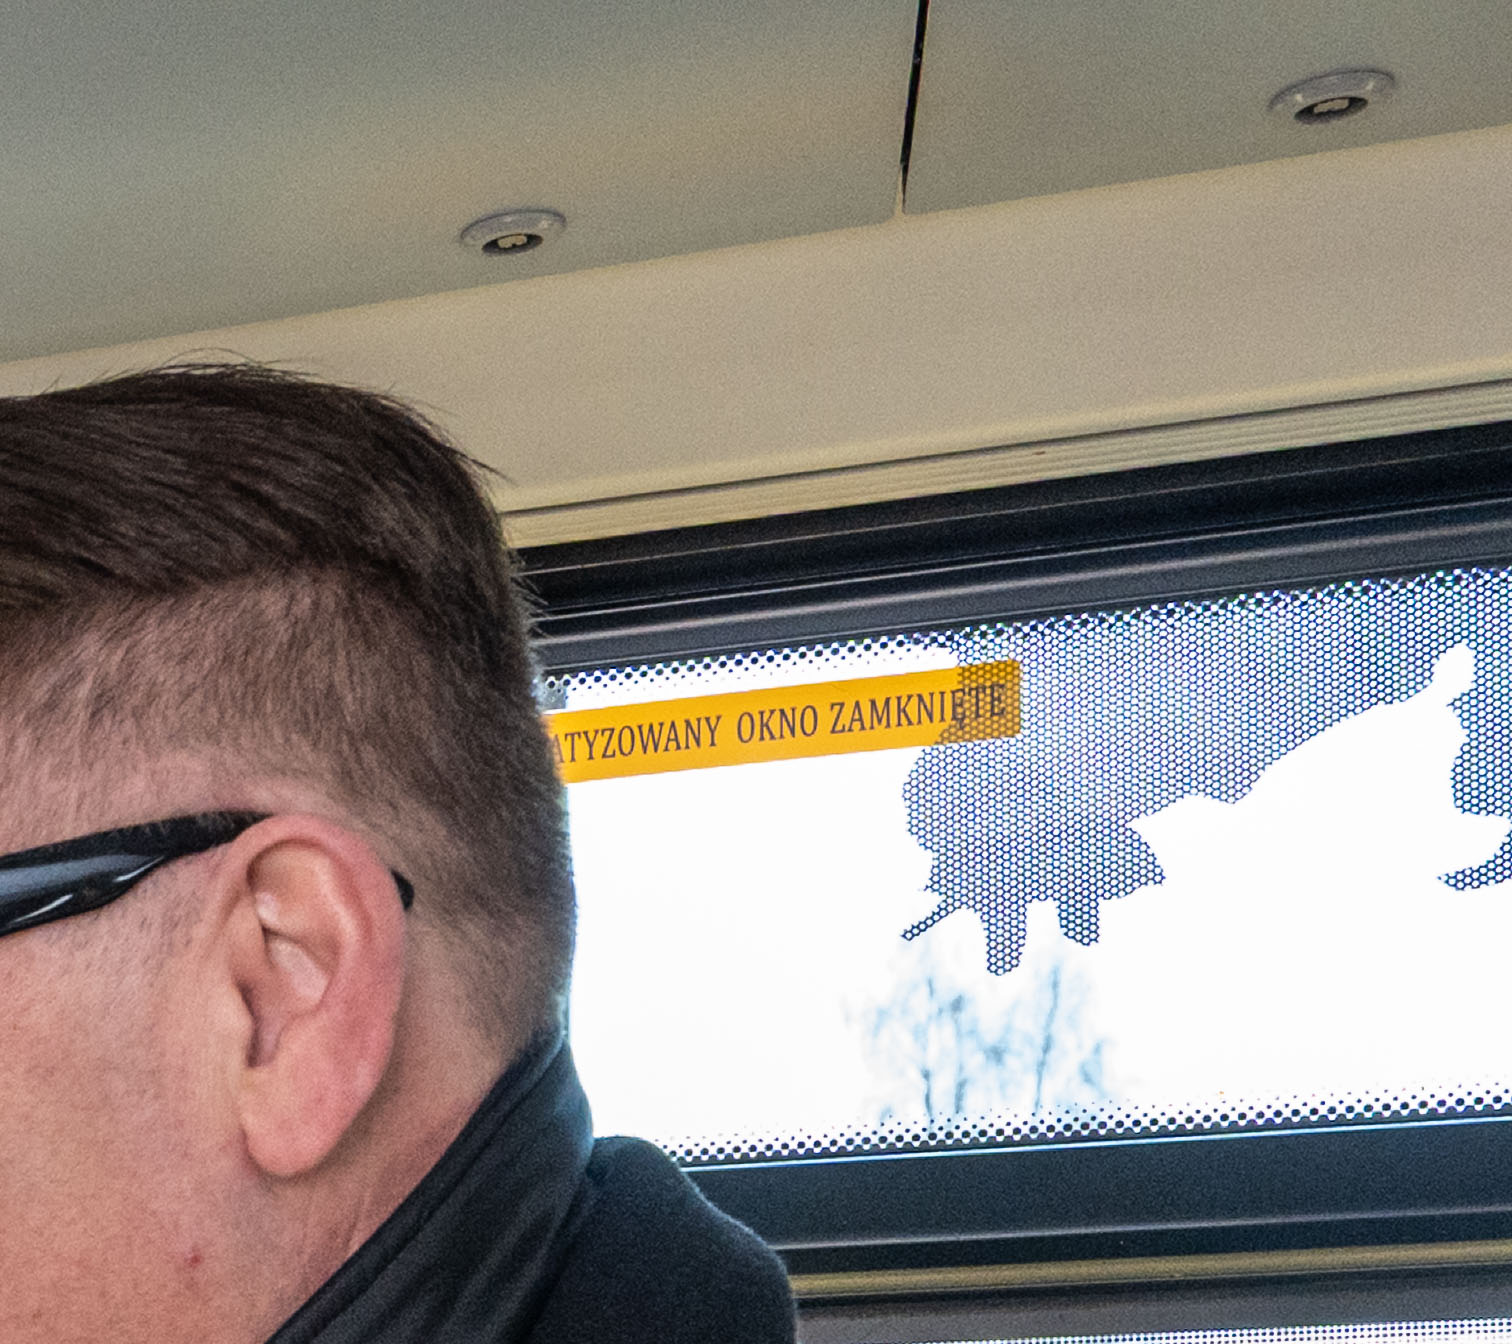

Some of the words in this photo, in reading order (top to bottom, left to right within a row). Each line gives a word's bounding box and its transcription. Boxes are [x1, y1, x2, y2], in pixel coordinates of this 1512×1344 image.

[554, 715, 723, 763] TYZOWANY
[737, 704, 818, 745] OKNO
[829, 683, 1007, 736] ZAMKNIĘTE
